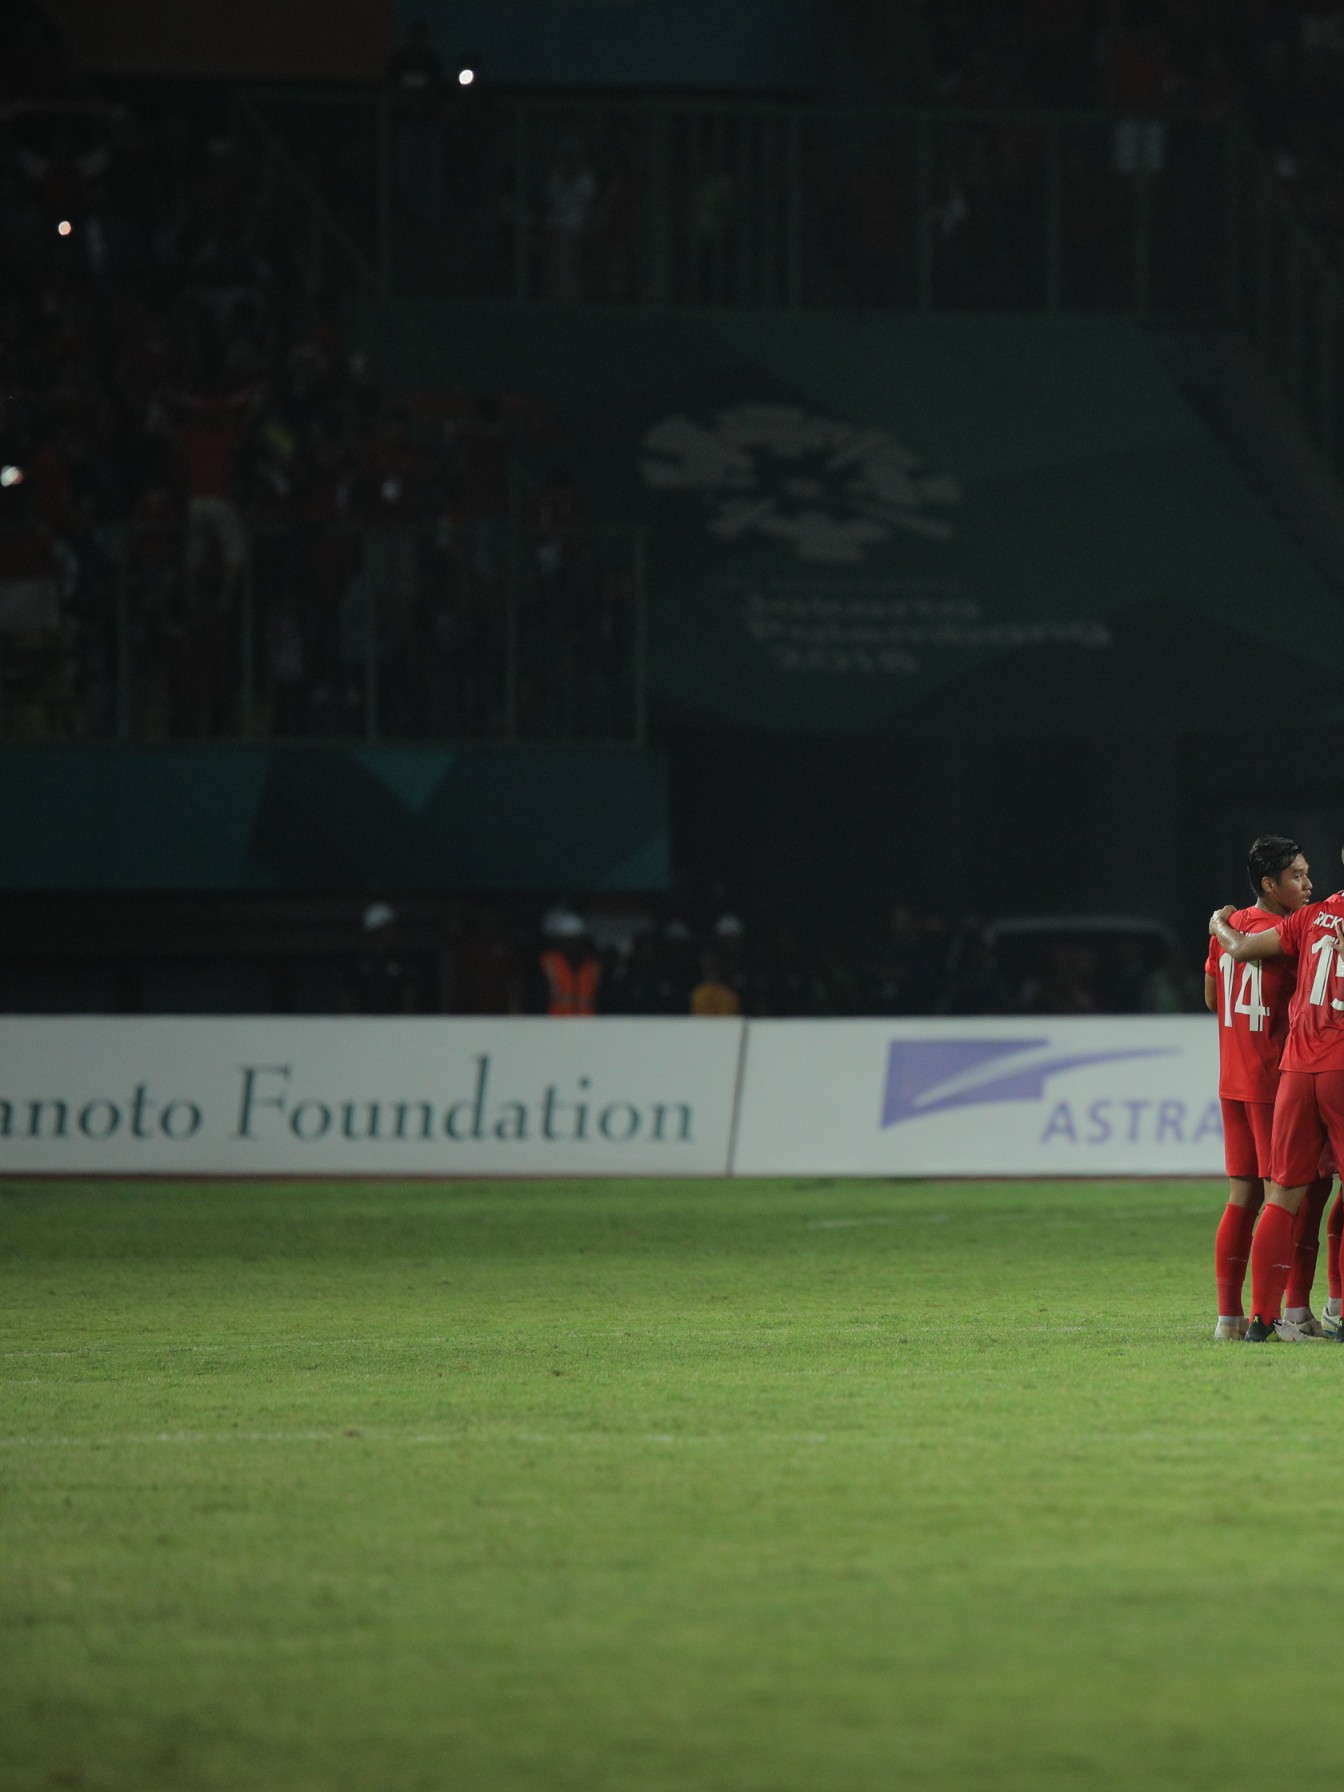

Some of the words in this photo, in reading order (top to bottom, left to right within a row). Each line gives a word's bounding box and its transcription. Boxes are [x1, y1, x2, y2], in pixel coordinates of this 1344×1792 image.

[1219, 953, 1270, 1031] 14
[231, 1053, 695, 1142] Foundation
[1040, 1099, 1224, 1146] ASTRA
